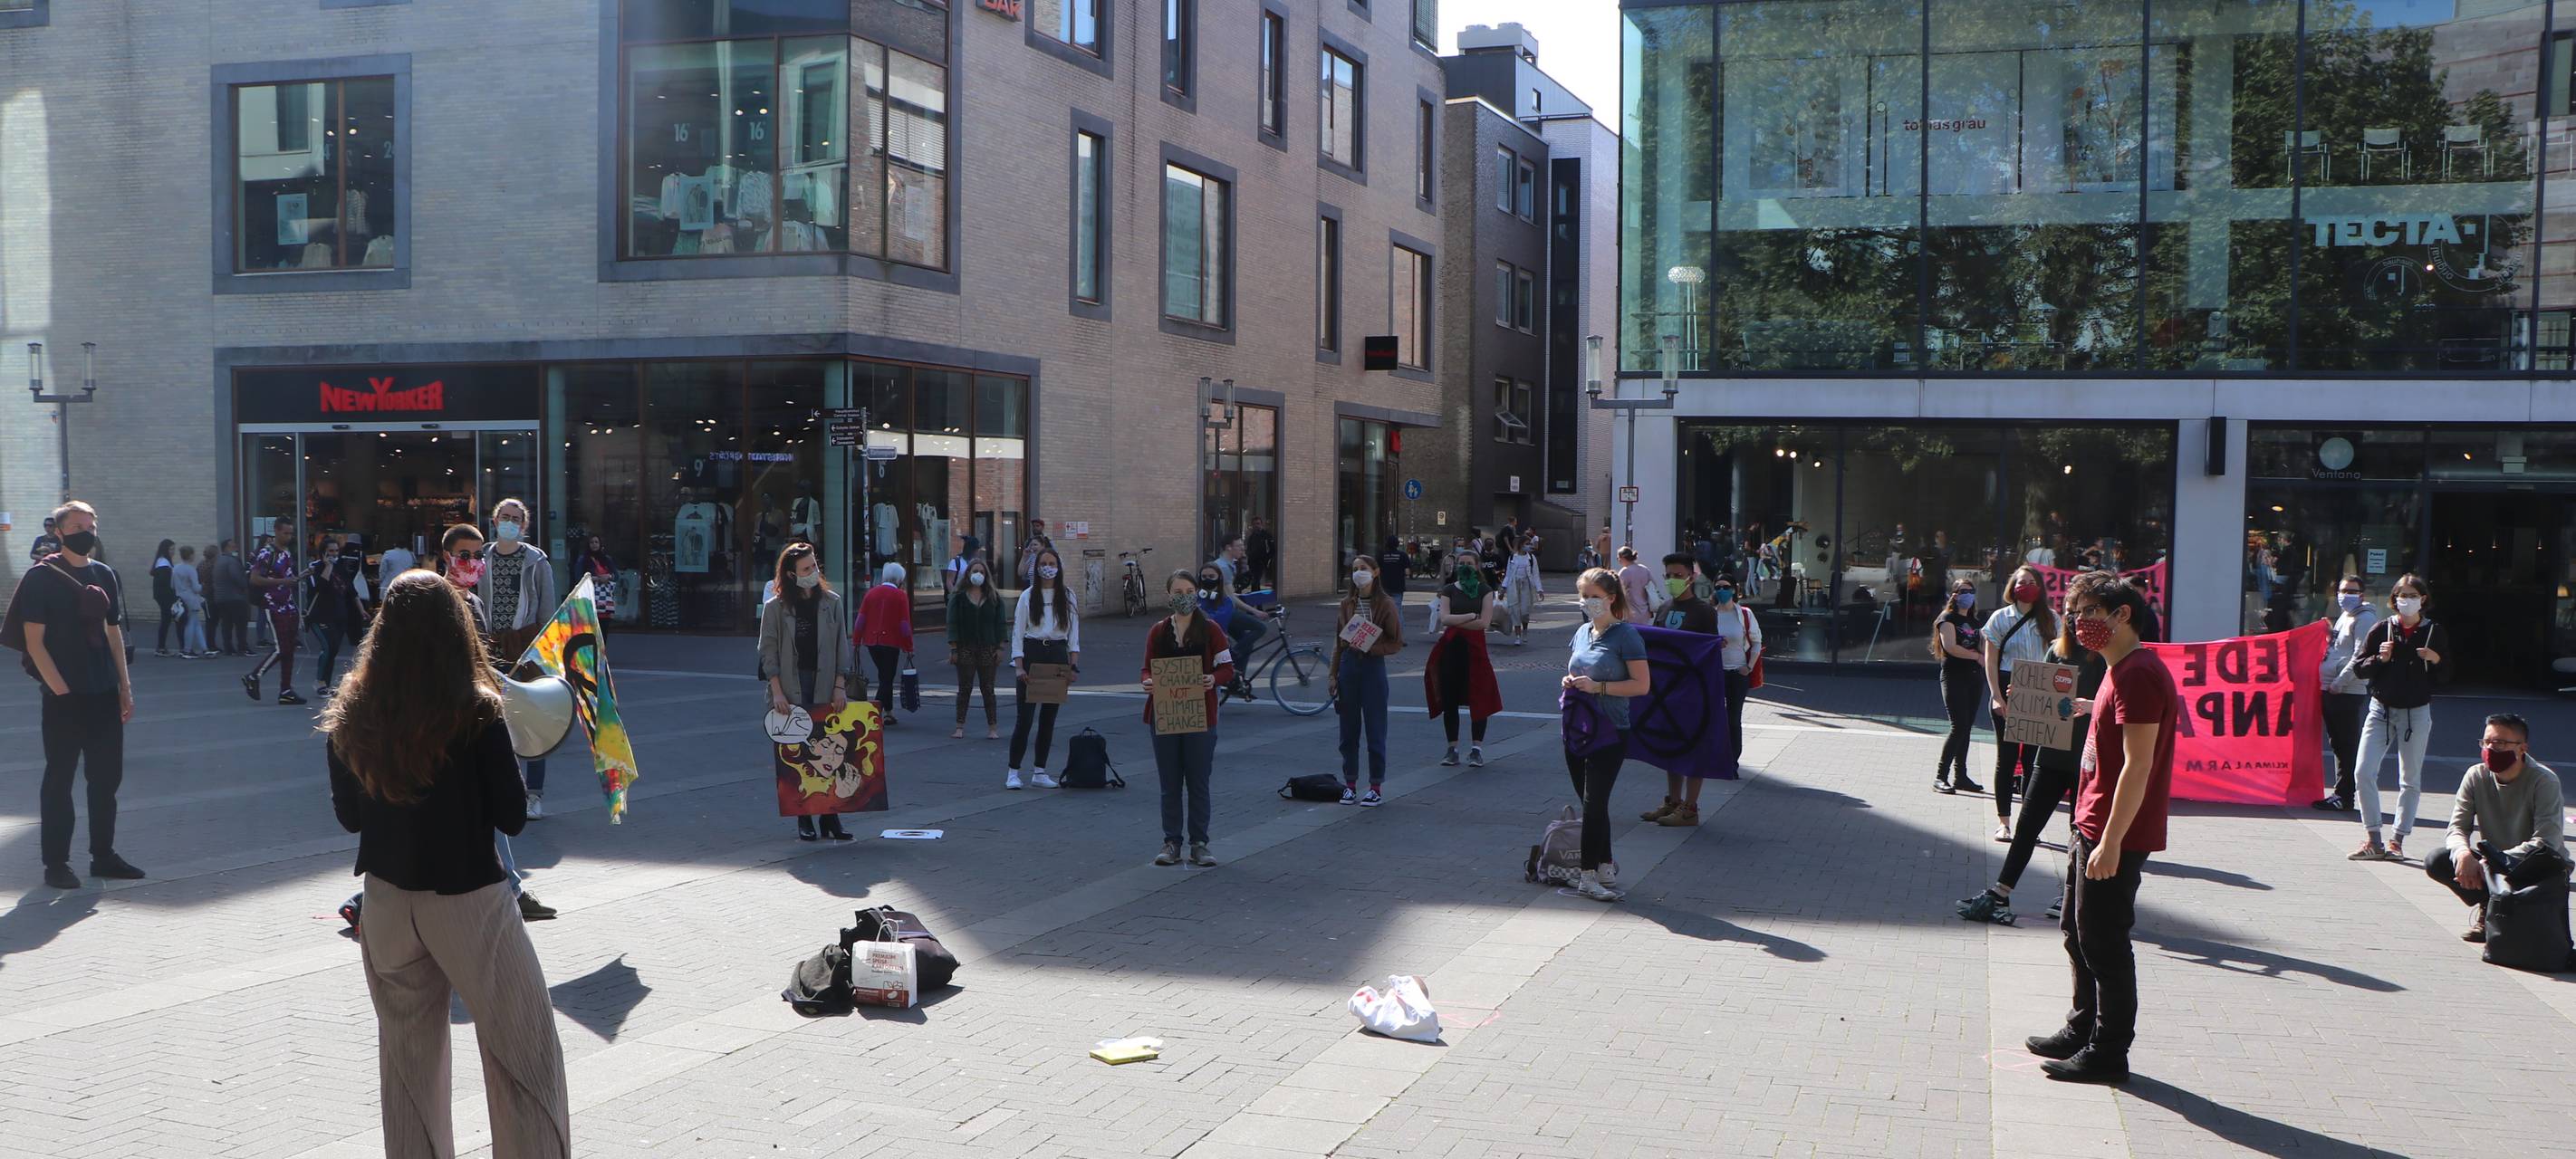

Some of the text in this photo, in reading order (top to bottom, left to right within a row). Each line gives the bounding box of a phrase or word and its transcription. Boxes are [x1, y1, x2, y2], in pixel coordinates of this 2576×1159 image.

[1903, 119, 1986, 132] toias grau
[2305, 214, 2463, 246] TECTA
[2312, 468, 2361, 480] Ventana
[1152, 659, 1202, 675] SYSTEM
[1160, 674, 1203, 687] CHANGE
[2013, 664, 2051, 692] KOHLE
[1169, 687, 1190, 700] NOT
[1158, 699, 1205, 716] CLIMATE
[2010, 692, 2053, 716] KLIMA
[1157, 715, 1205, 732] CHANGE
[2006, 716, 2057, 745] RETTEN
[1558, 849, 1581, 860] VAN
